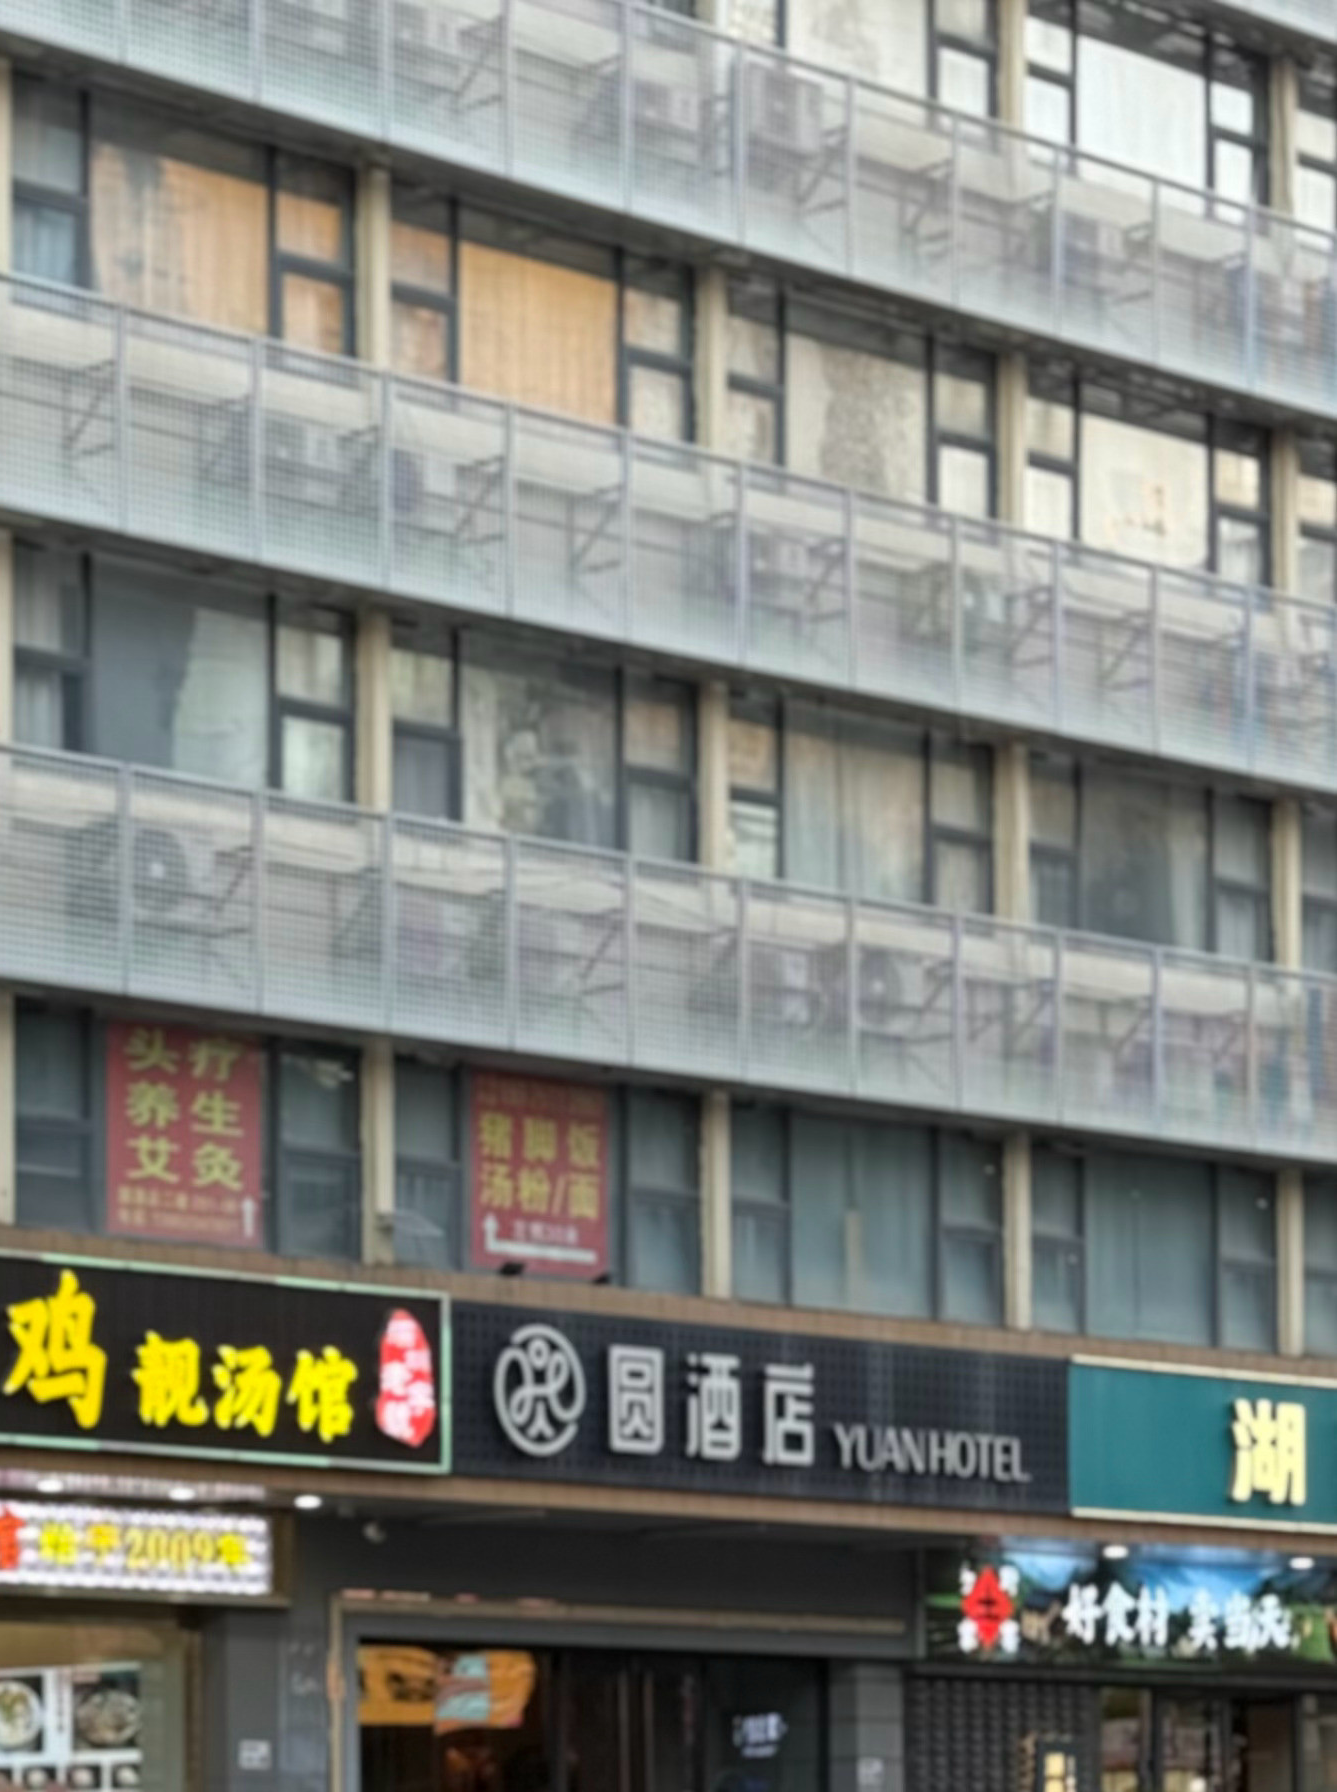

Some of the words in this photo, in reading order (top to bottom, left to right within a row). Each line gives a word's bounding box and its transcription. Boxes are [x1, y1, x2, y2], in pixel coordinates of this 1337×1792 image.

[126, 1080, 244, 1137] 养生
[126, 1136, 243, 1192] 艾灸
[608, 1344, 814, 1467] 圆酒店
[834, 1424, 926, 1473] YUAN
[928, 1432, 1031, 1483] HOTEL
[1231, 1398, 1308, 1506] 湖
